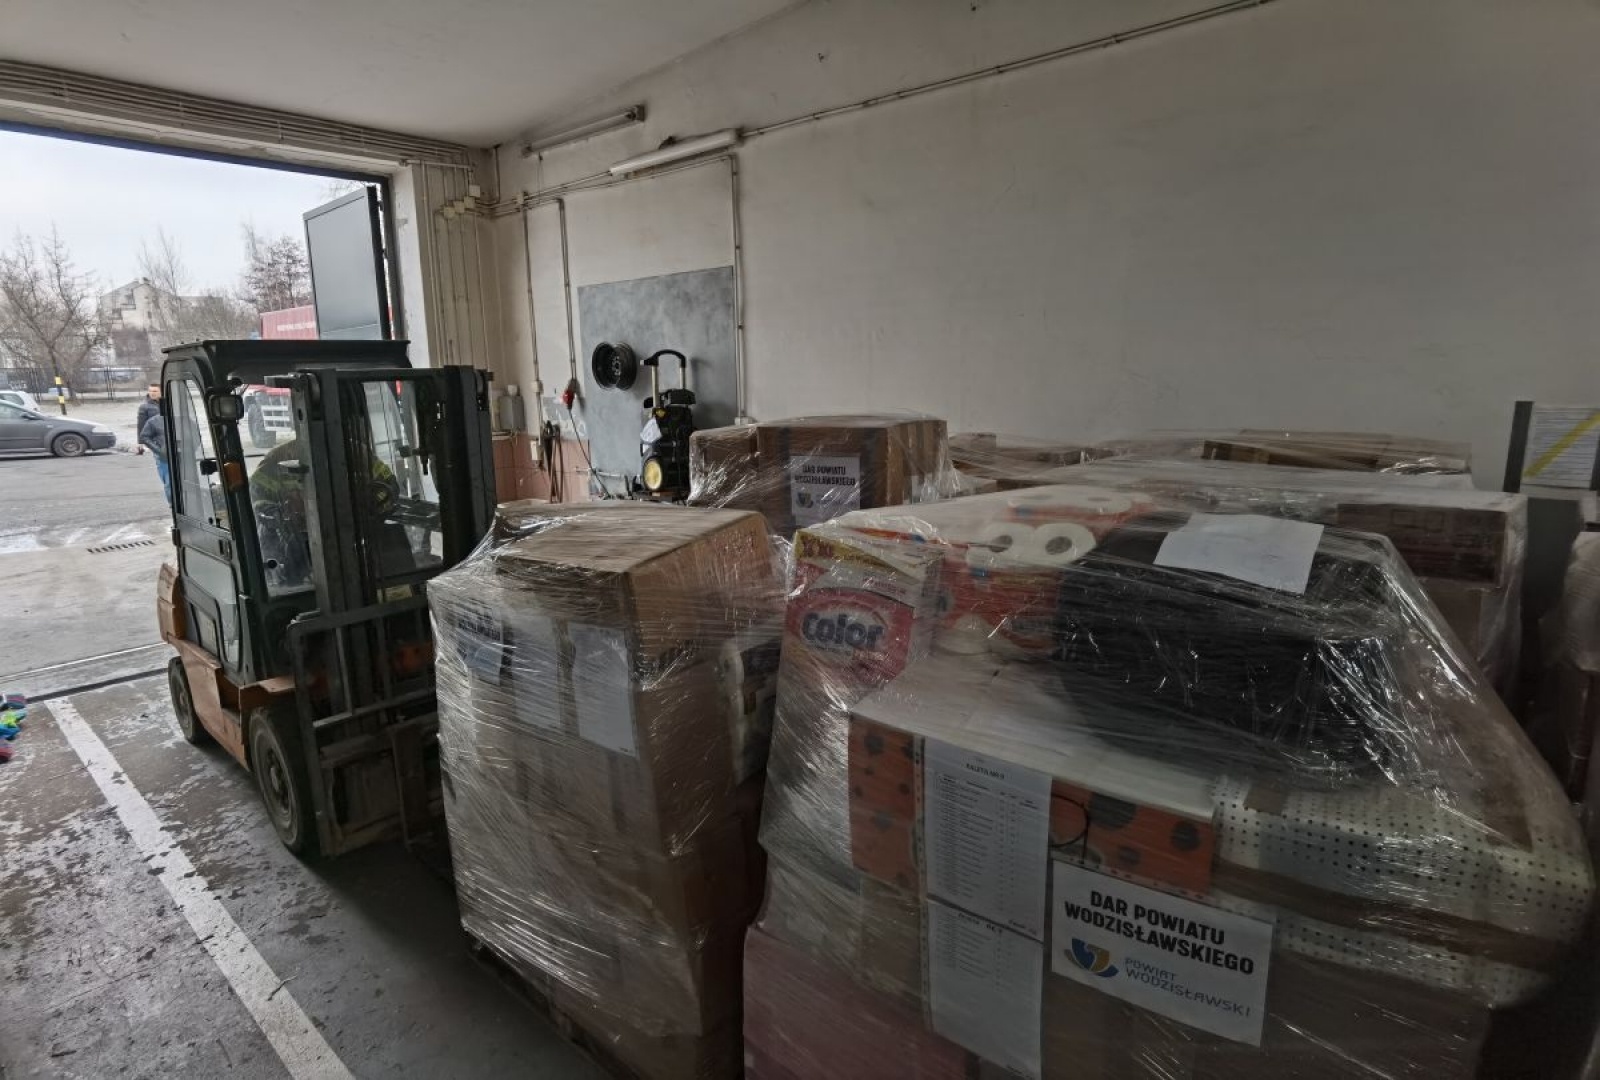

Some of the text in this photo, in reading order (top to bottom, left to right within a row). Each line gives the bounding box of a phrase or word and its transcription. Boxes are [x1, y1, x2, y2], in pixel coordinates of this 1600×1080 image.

[817, 465, 846, 475] POWIATU
[803, 612, 885, 649] Color
[1064, 901, 1255, 975] WODZISŁAWSKIEGO
[1090, 890, 1225, 945] DAR POWIATU
[1124, 957, 1177, 982] POWIAT
[1125, 967, 1251, 1018] WODZISŁAWSKI
